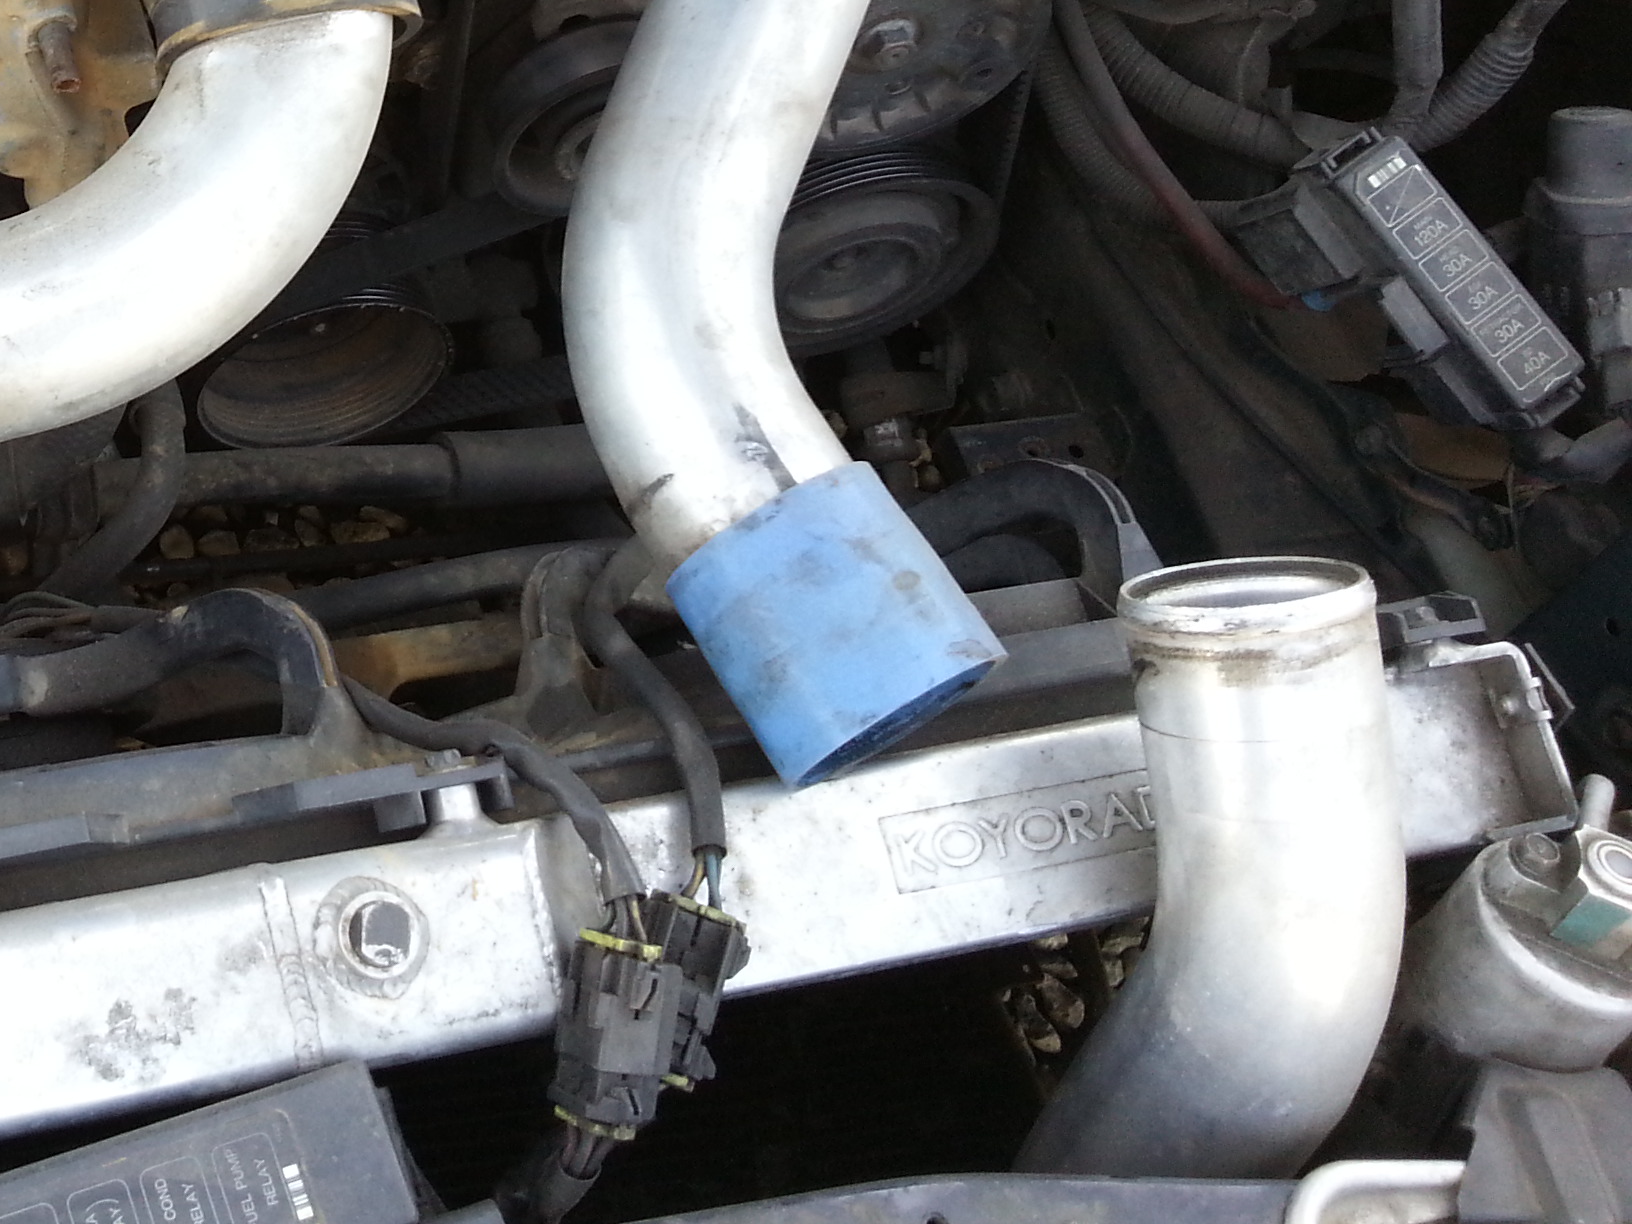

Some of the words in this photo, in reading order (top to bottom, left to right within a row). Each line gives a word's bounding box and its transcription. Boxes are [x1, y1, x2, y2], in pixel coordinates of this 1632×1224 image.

[1414, 219, 1448, 247] 120A
[1442, 253, 1473, 277] 30A
[1468, 285, 1499, 310] 30A
[1494, 318, 1525, 344] 30A
[1523, 351, 1551, 375] 40A
[224, 1148, 248, 1192] PUMP
[253, 1158, 279, 1206] RELAY
[154, 1178, 177, 1222] COND
[241, 1193, 259, 1224] UEL
